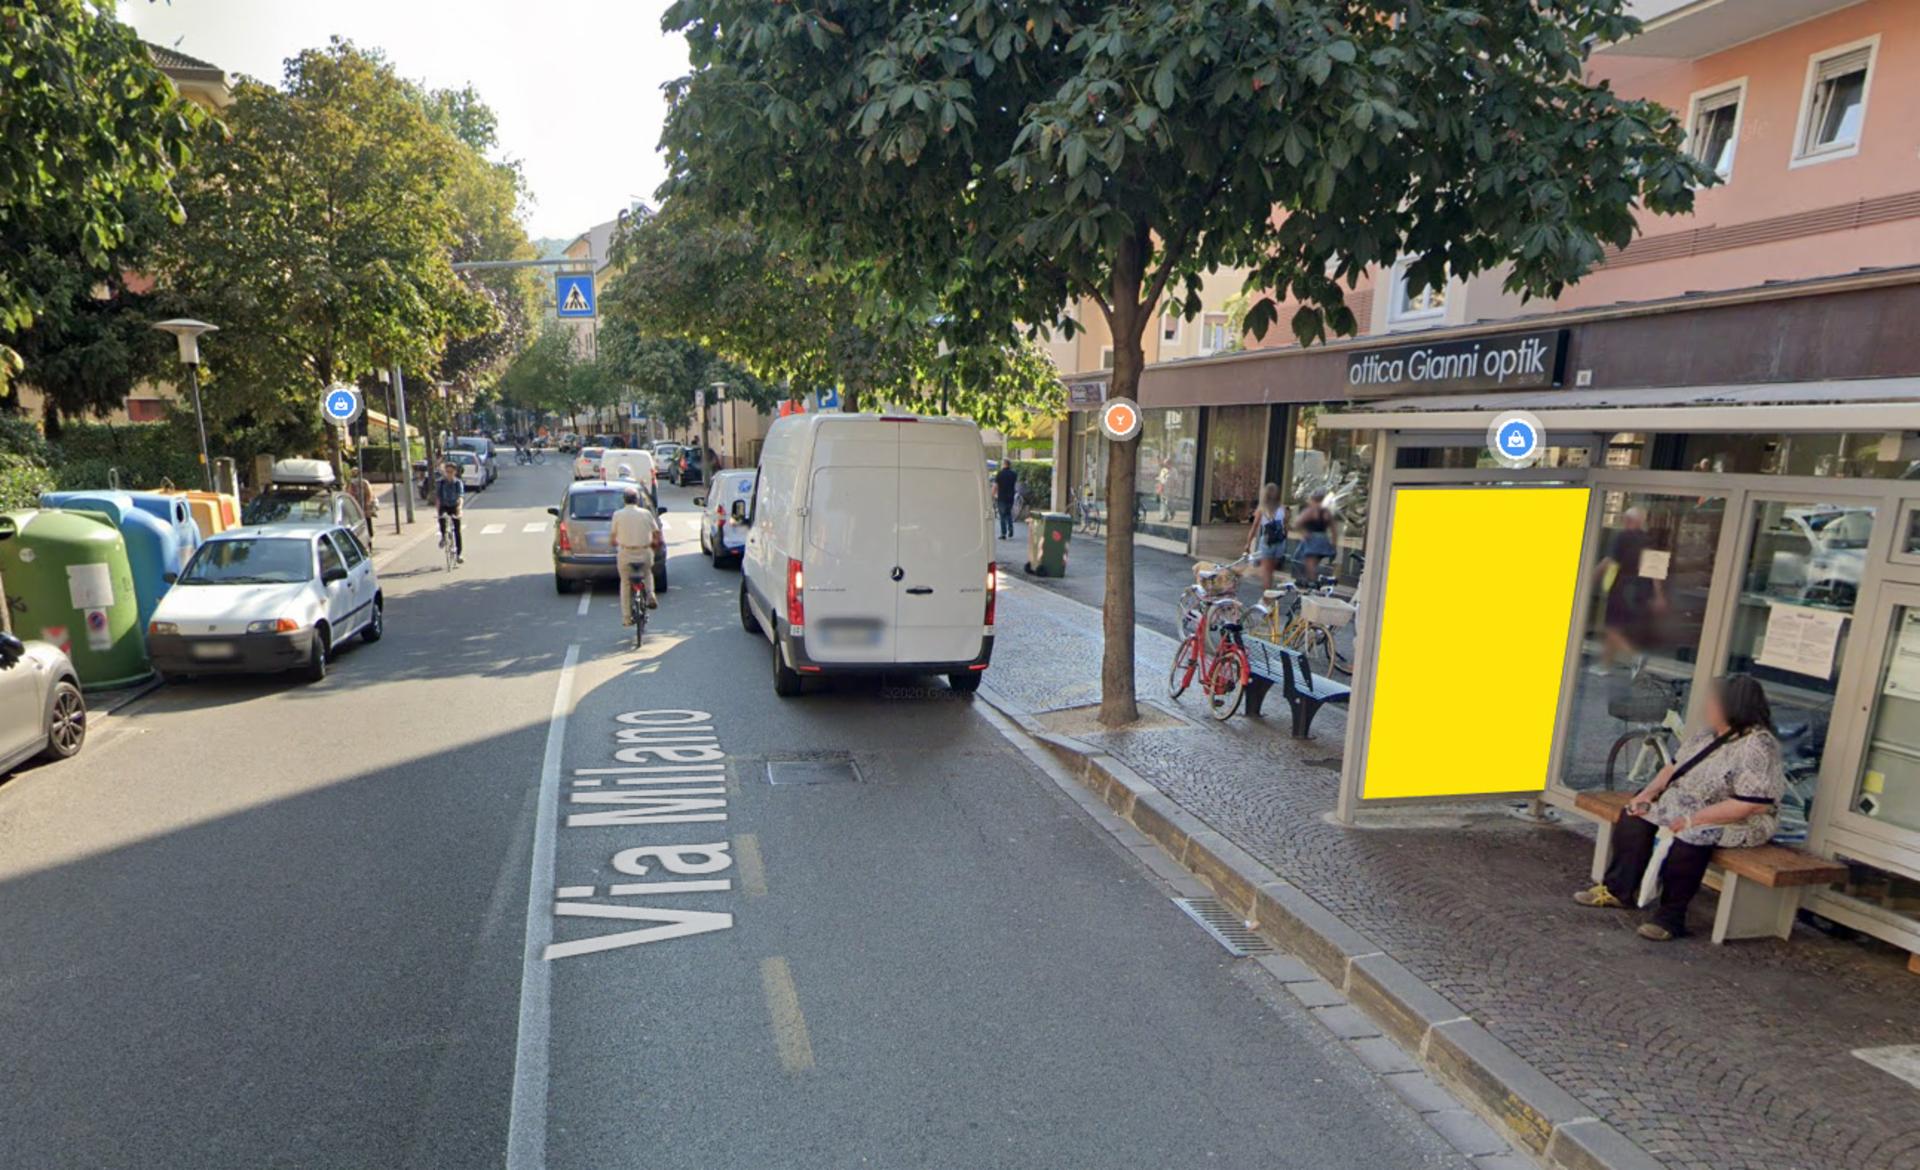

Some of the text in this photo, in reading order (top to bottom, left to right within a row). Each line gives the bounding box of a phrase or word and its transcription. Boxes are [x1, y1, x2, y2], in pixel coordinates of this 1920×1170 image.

[1350, 338, 1548, 385] ottica Gianni optik
